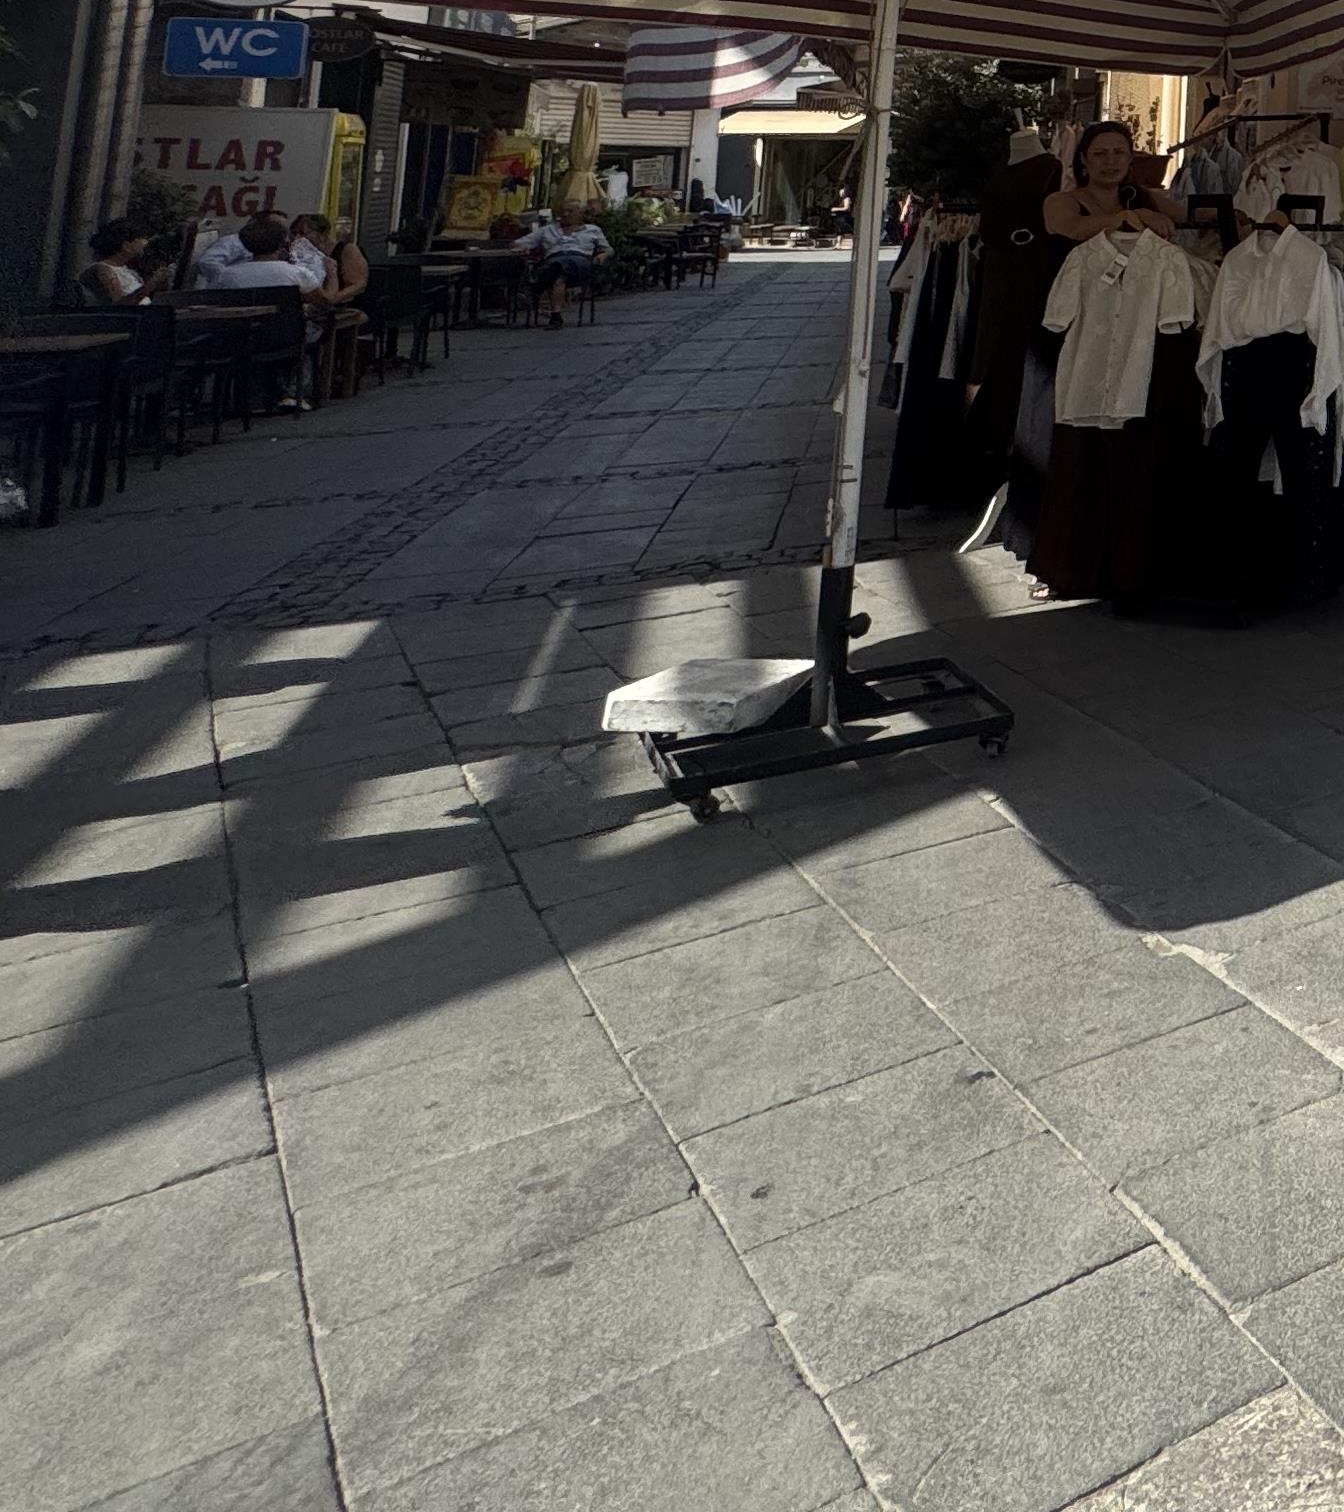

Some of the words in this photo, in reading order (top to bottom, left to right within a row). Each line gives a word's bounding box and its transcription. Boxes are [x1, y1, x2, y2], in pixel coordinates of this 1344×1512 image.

[194, 25, 280, 56] WC
[308, 28, 365, 40] OSTLAR
[133, 137, 286, 172] TLAR
